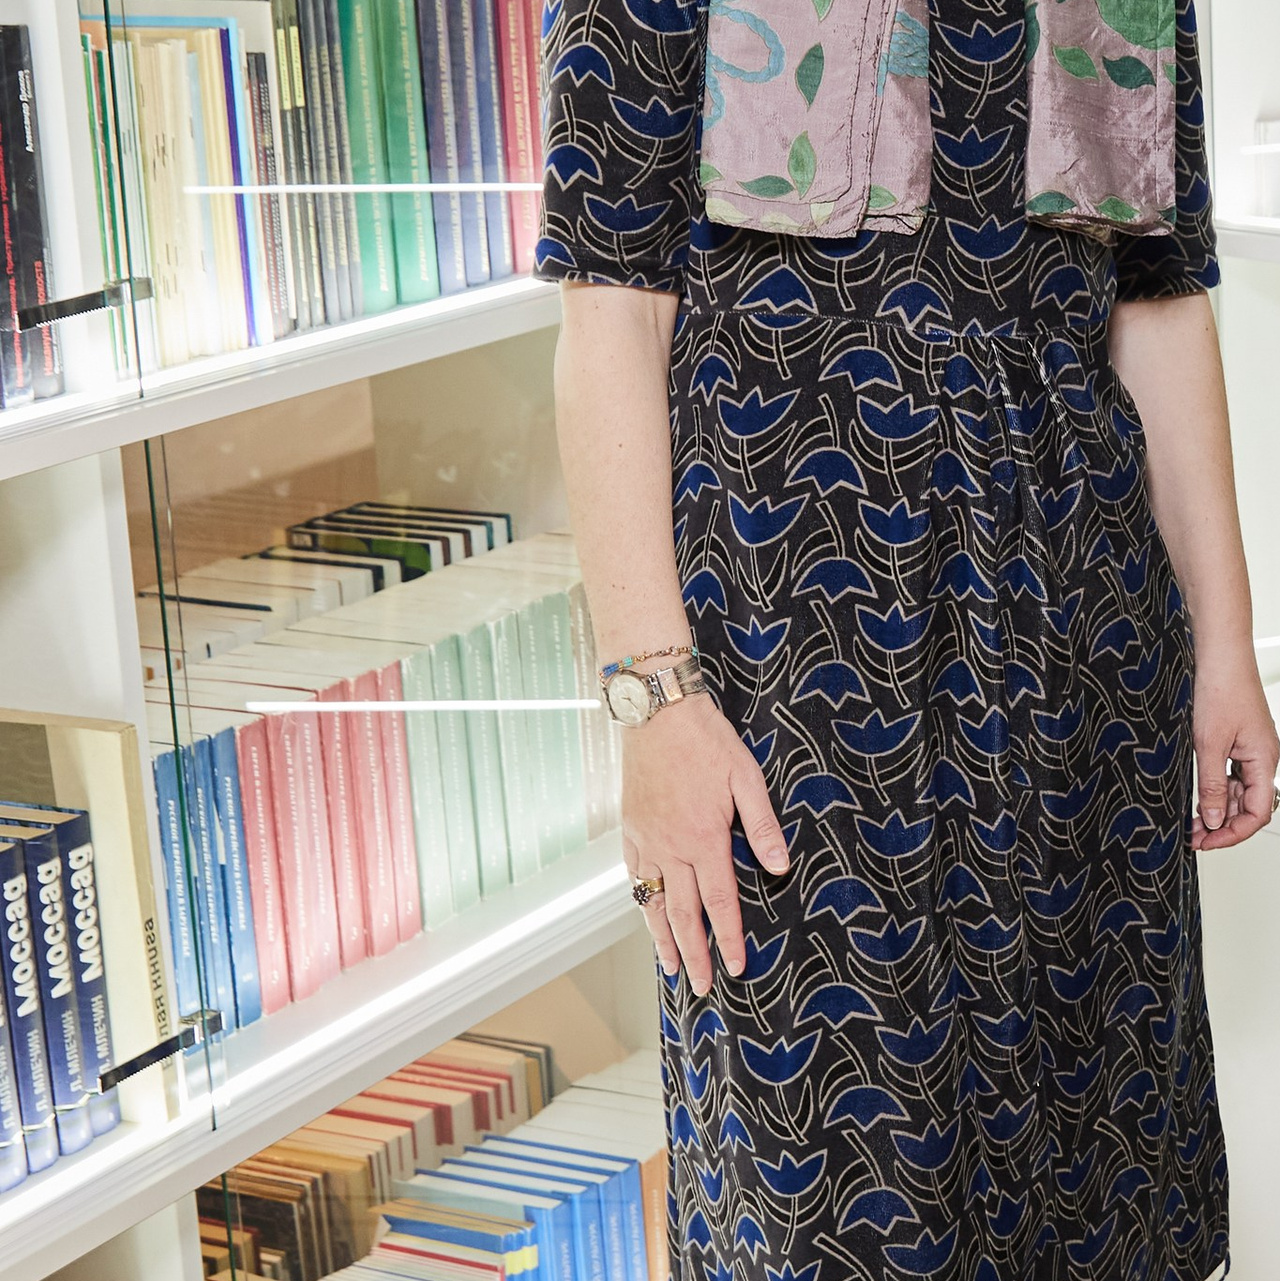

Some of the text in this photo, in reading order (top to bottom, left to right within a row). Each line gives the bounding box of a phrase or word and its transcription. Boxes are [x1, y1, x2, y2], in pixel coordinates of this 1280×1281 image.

[1, 873, 39, 1017] Моссад
[35, 857, 72, 998] Моссад
[68, 842, 104, 983] Моссад
[27, 1030, 45, 1093] МЛЕЧИН
[62, 1010, 81, 1073] МЛЕЧИН
[92, 994, 109, 1058] МЛЕЧИН
